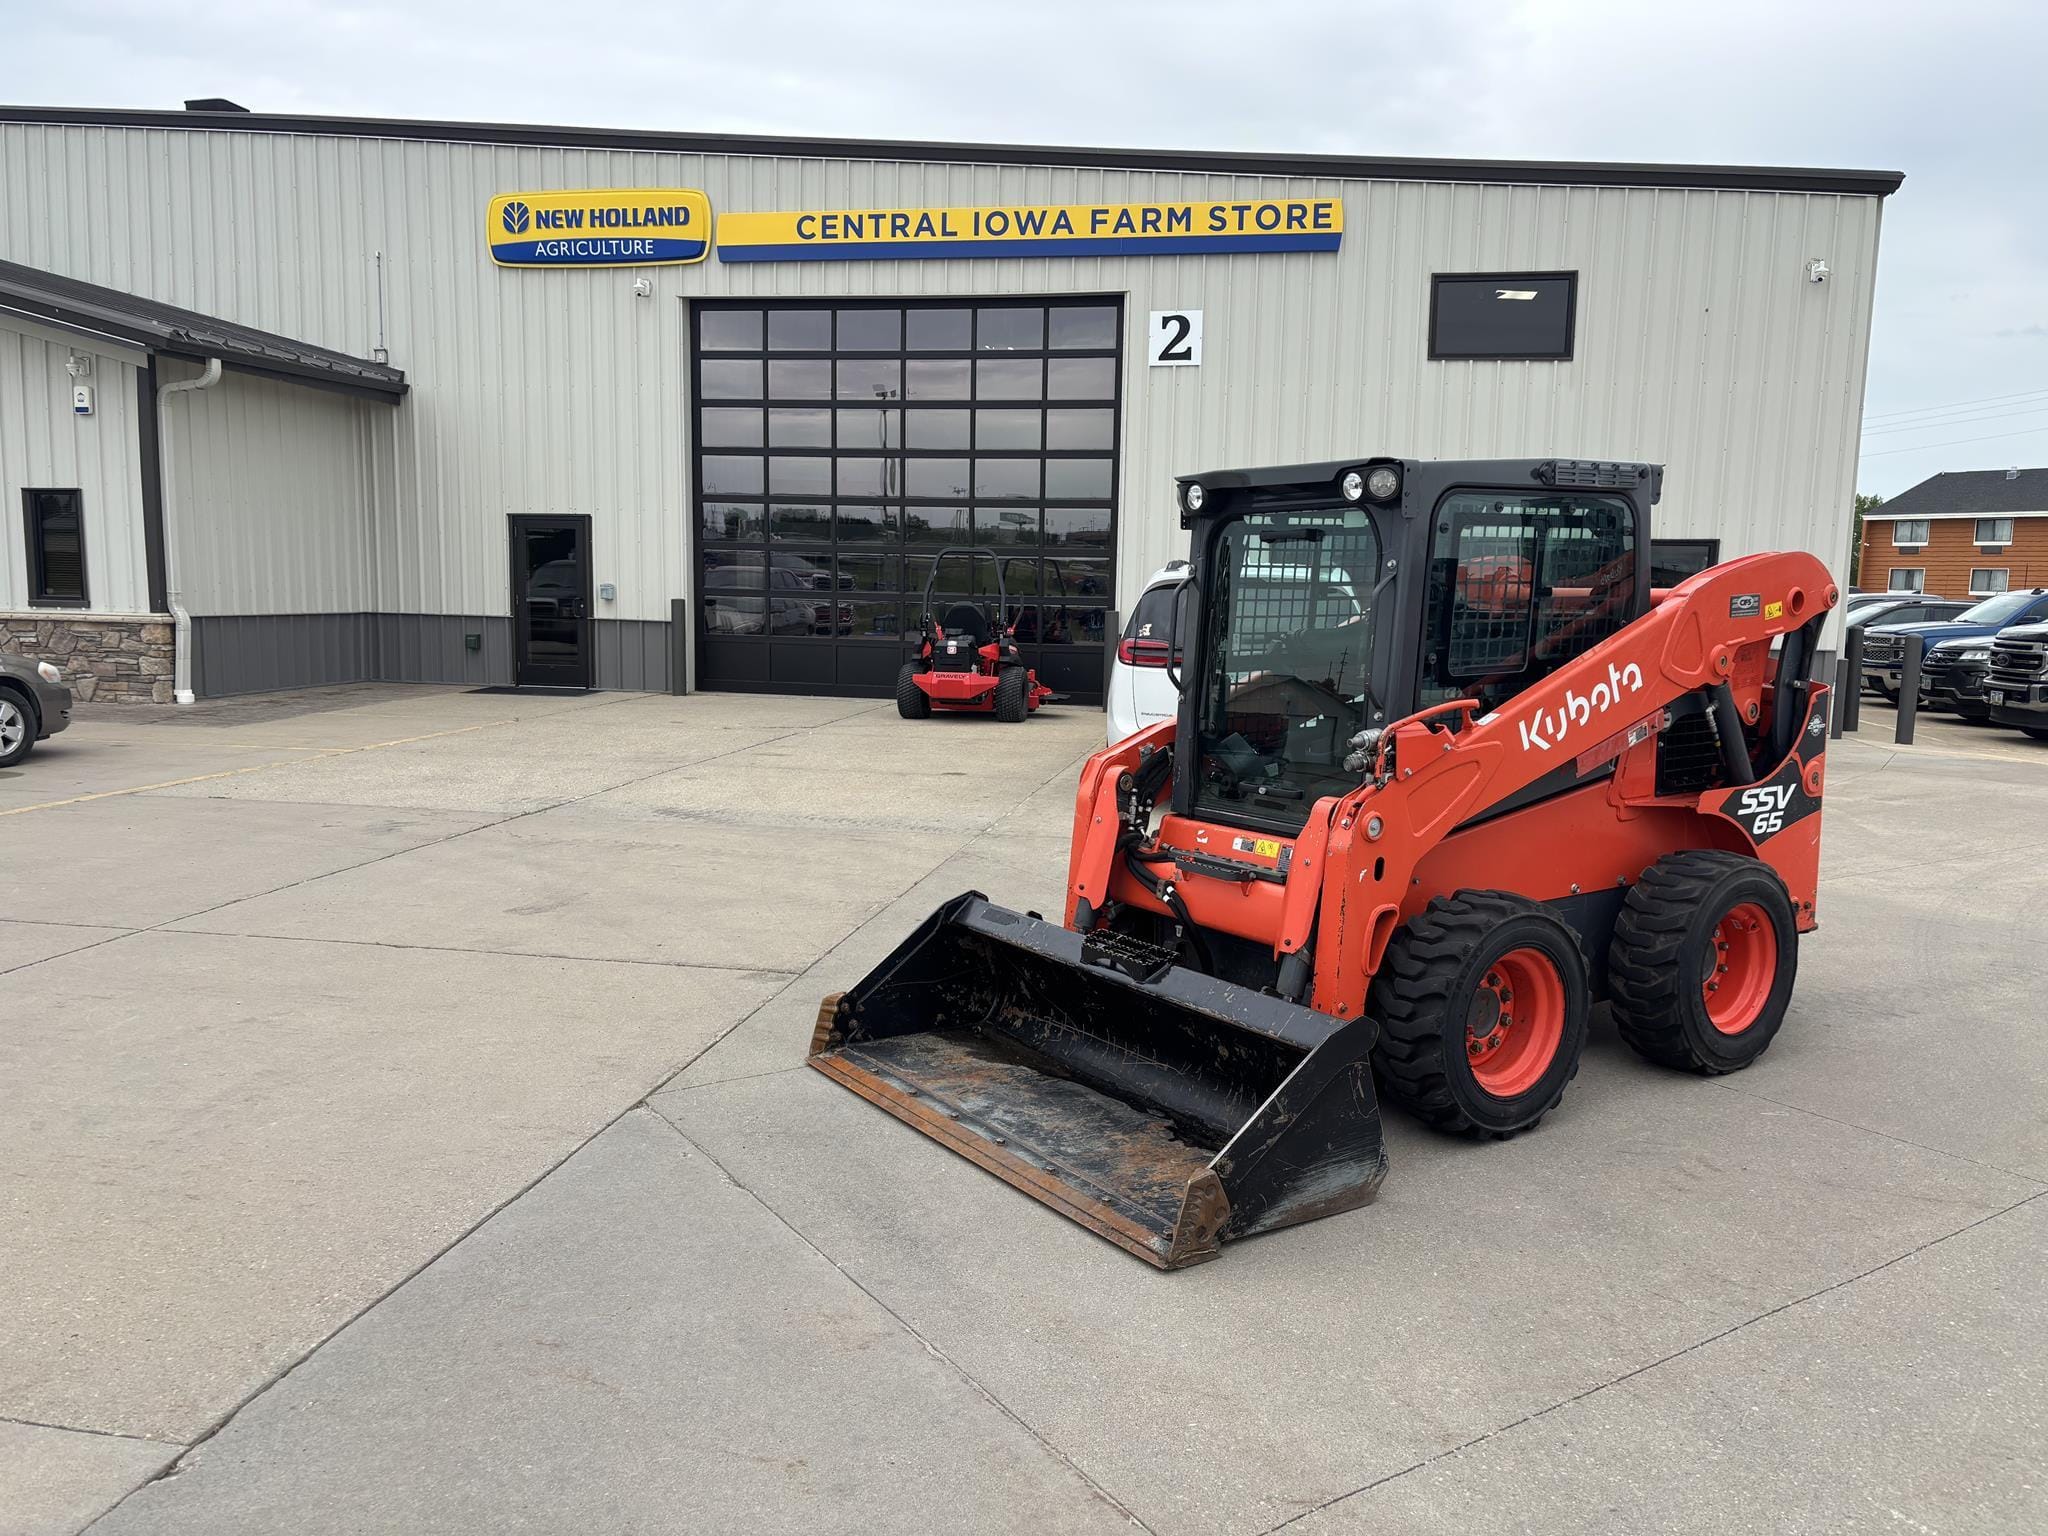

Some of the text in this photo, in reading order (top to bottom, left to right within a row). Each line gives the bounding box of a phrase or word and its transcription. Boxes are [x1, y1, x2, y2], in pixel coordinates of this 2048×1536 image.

[535, 206, 690, 230] NEW HOLLAND
[796, 202, 1333, 240] CENTRAL IOWA FARM STORE
[535, 239, 654, 257] AGRICULTURE
[1158, 314, 1192, 361] 2
[1518, 662, 1643, 751] Kubota
[1737, 783, 1797, 815] SSV
[1752, 811, 1784, 835] 65
